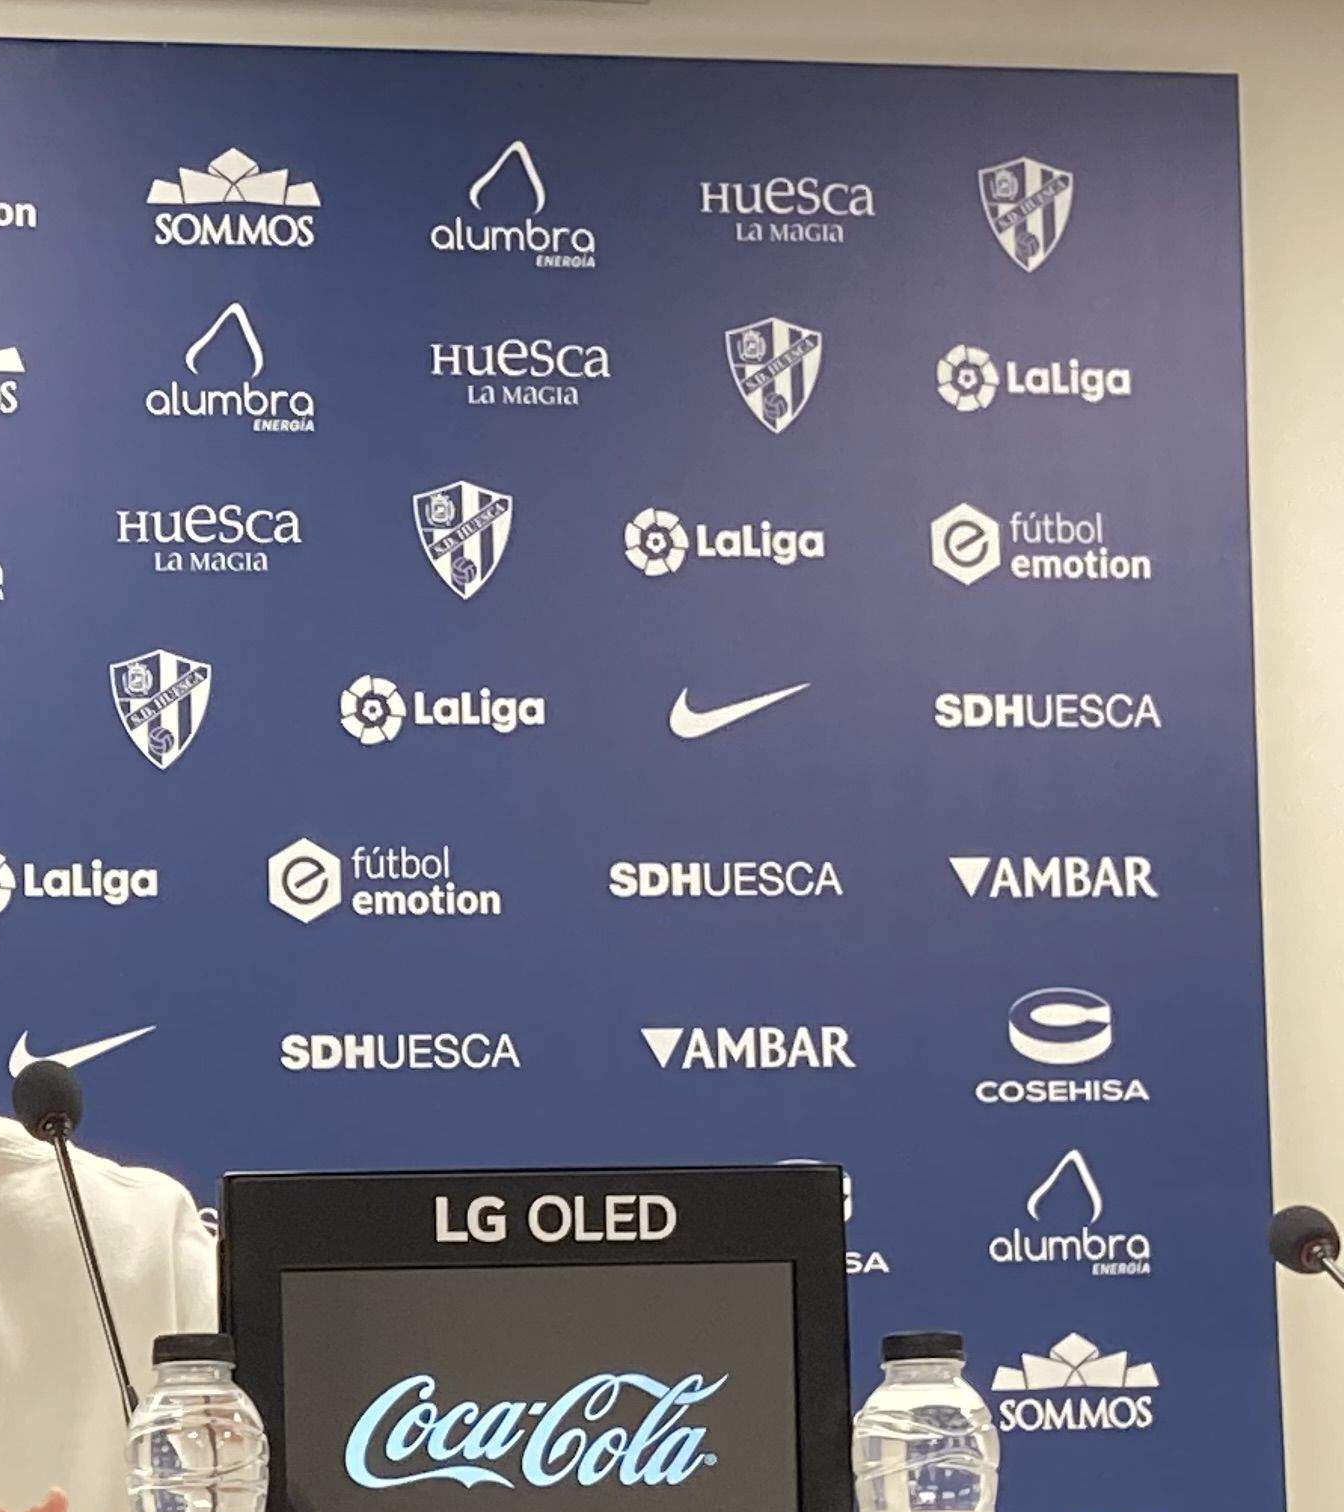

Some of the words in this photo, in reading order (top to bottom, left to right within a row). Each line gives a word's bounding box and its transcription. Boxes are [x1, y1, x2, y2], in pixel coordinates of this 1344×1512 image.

[155, 213, 314, 247] SOMMOS
[431, 217, 595, 252] alumbra
[1007, 359, 1130, 402] LaLiga
[146, 381, 314, 416] alumbra
[697, 521, 824, 565] LaLiga
[1010, 512, 1102, 544] fútbol
[1011, 547, 1151, 579] emotion
[415, 688, 544, 733] LaLiga
[935, 693, 1161, 728] SDHUESCA
[352, 846, 449, 879] fútbol
[609, 862, 843, 897] SDHUESCA
[990, 856, 1158, 897] AMBAR
[24, 859, 157, 904] LaLiga
[353, 882, 500, 915] emotion
[281, 1034, 520, 1069] SDHUESCA
[682, 1027, 855, 1069] AMBAR
[976, 1080, 1149, 1102] COSEHISA
[436, 1196, 508, 1242] LG
[529, 1195, 676, 1242] OLED
[989, 1227, 1149, 1262] alumbra
[345, 1374, 728, 1488] Coca-Cola
[1000, 1396, 1152, 1431] SOMMOS
